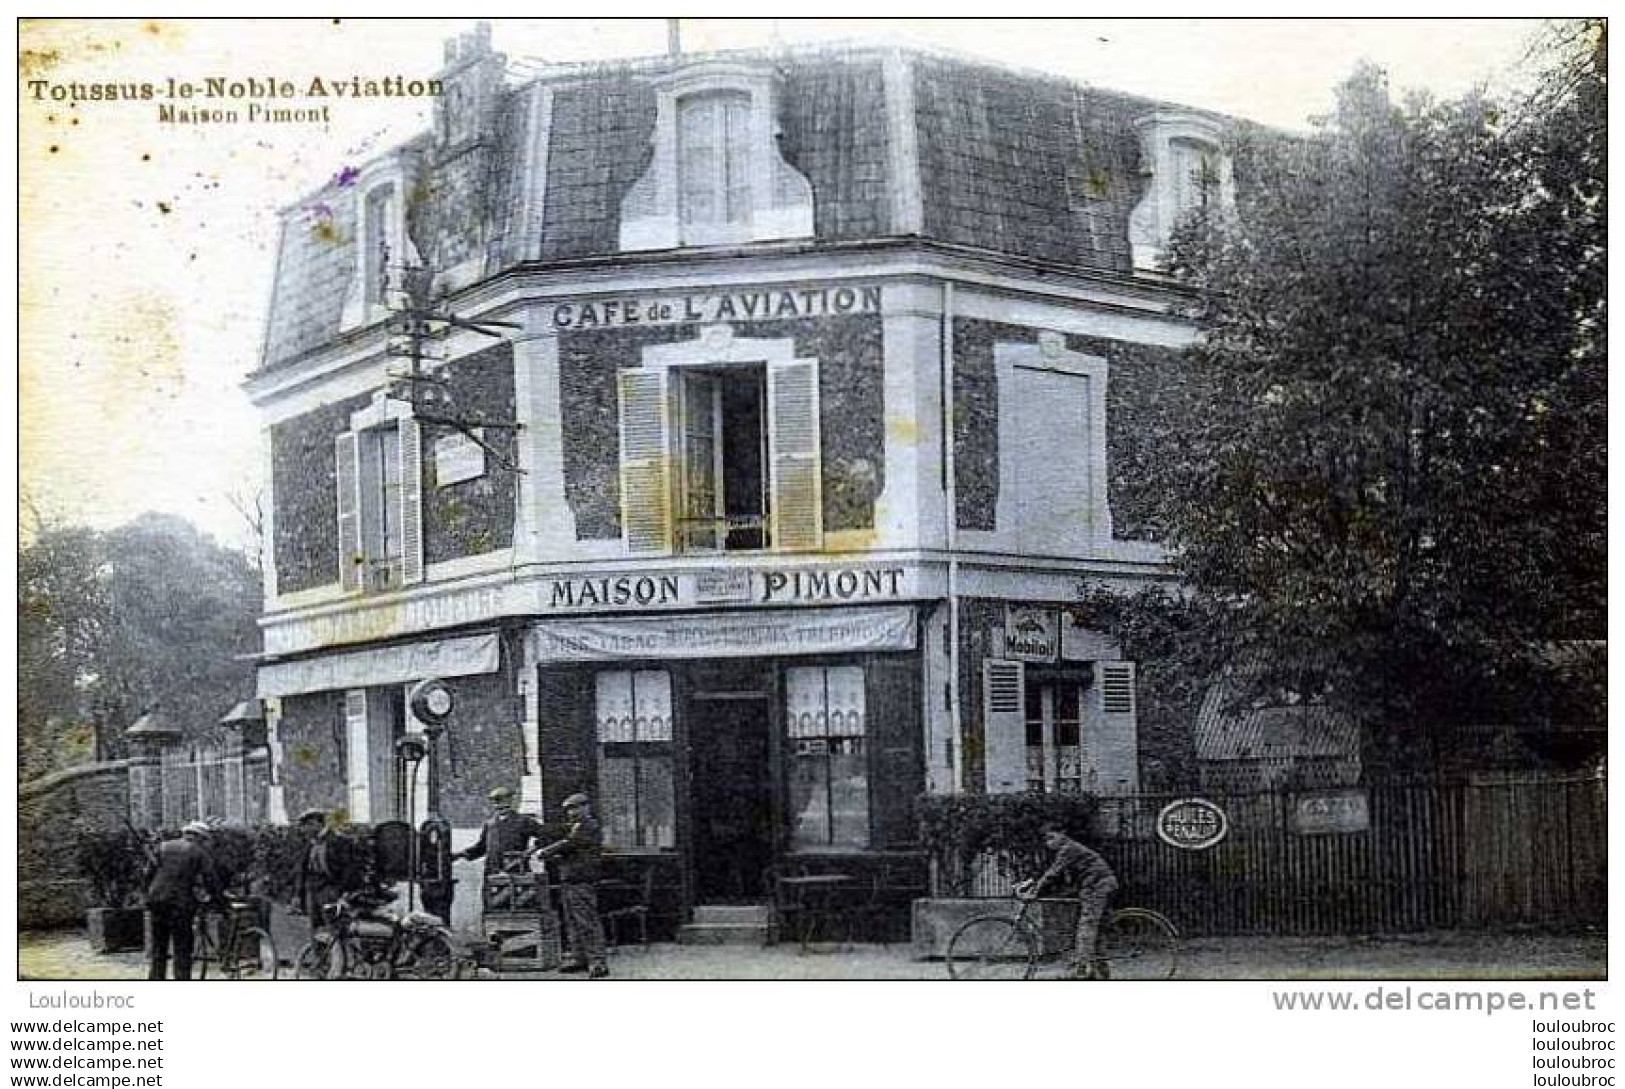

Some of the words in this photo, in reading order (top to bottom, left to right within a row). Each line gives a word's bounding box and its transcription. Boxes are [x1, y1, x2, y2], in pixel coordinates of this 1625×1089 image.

[649, 301, 671, 320] de
[549, 576, 679, 608] MAISON
[762, 569, 905, 601] PIMONT
